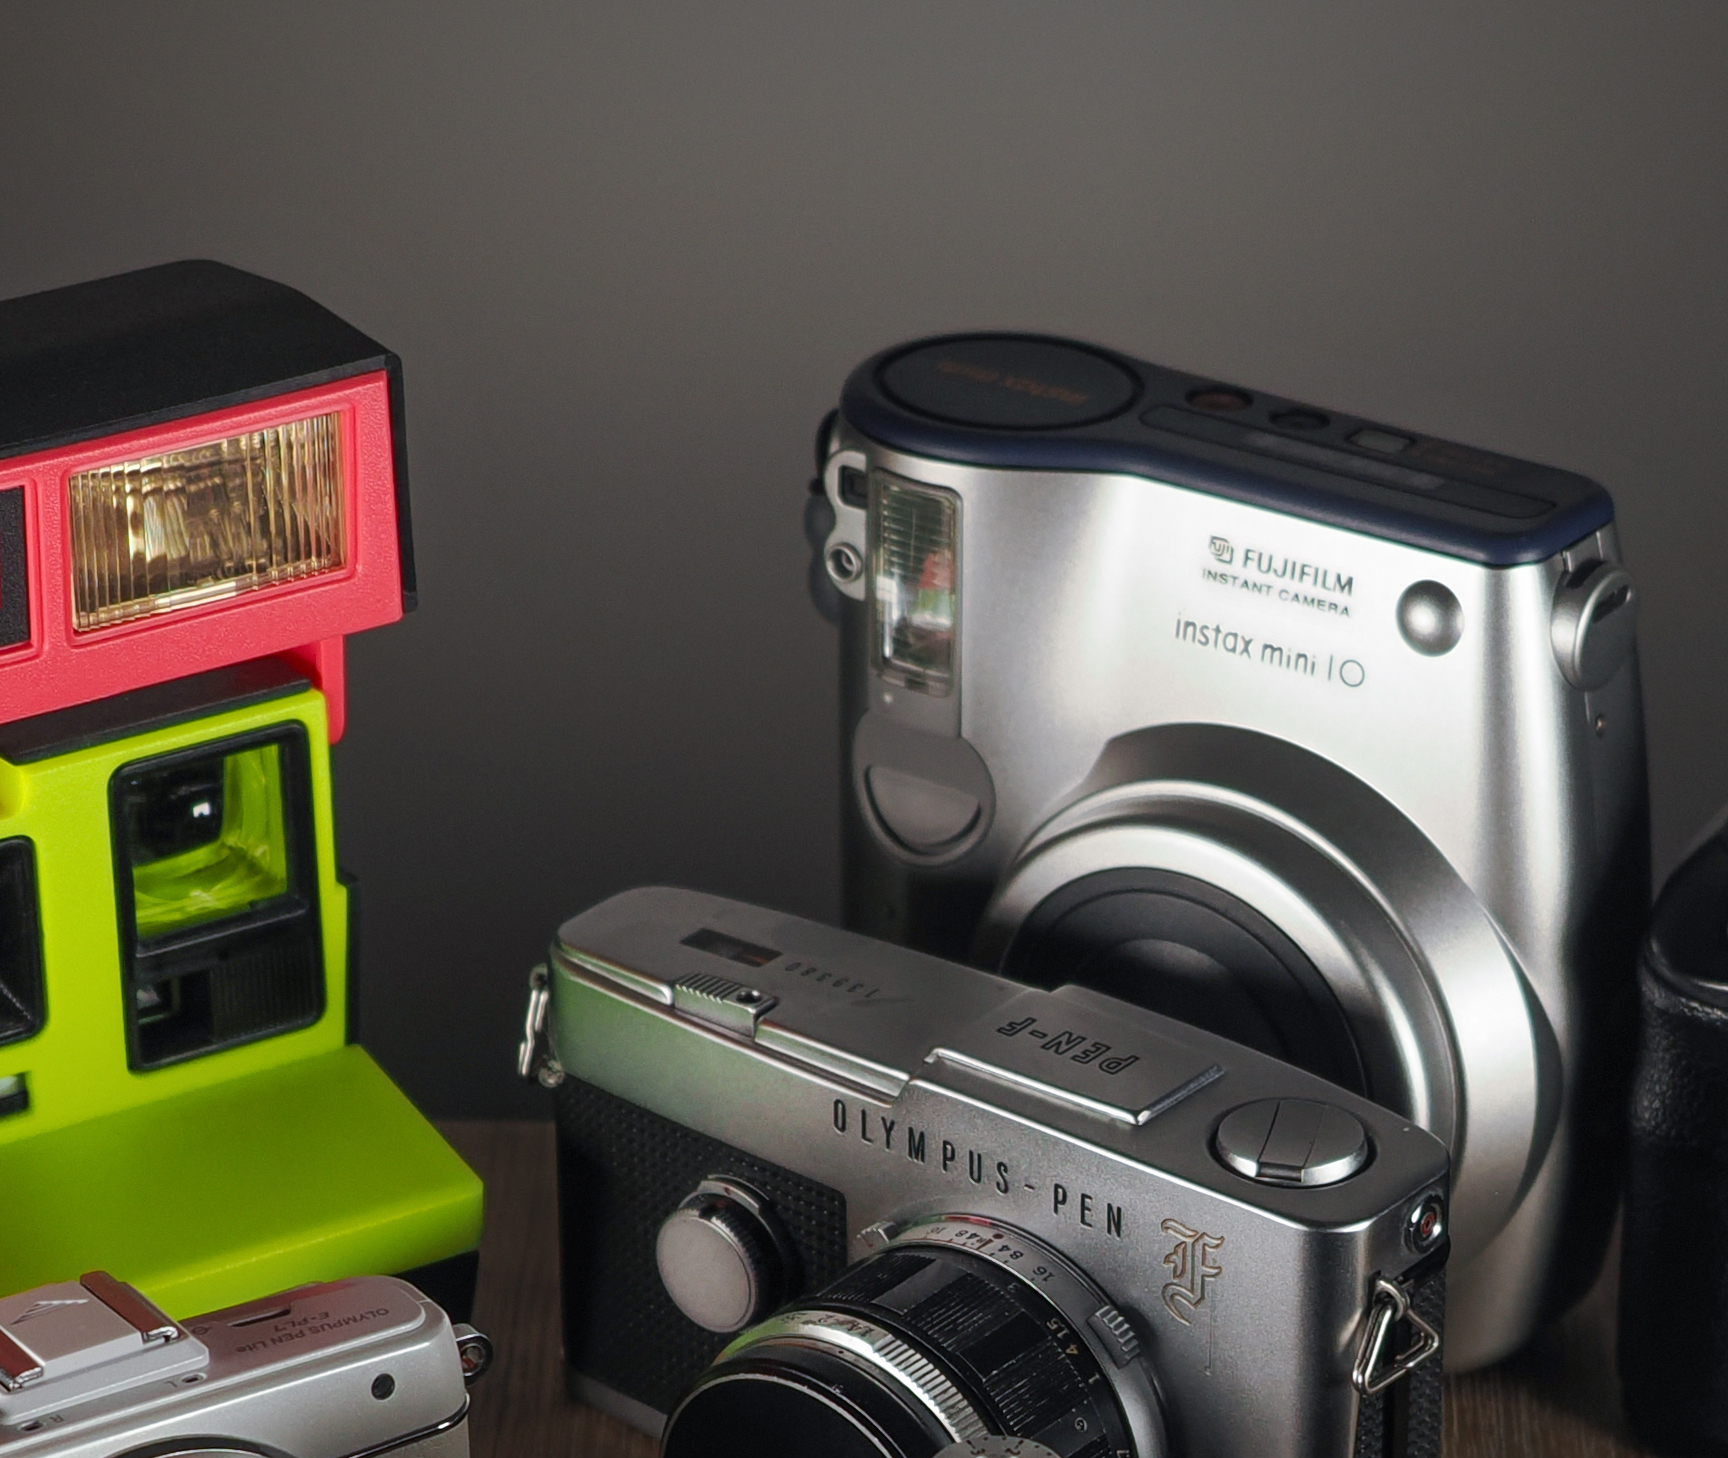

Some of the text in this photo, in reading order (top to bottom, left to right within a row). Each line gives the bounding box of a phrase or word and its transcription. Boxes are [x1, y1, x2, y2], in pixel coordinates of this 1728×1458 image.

[1202, 568, 1350, 617] INSTANT CAMERA
[1243, 549, 1353, 597] FUJIFILM
[1175, 612, 1253, 659] instax
[1261, 643, 1316, 676] mini
[997, 1017, 1140, 1075] PEN-F
[271, 1329, 306, 1346] PEN
[274, 1311, 330, 1332] E-PL7
[307, 1307, 390, 1335] OLYMPUS
